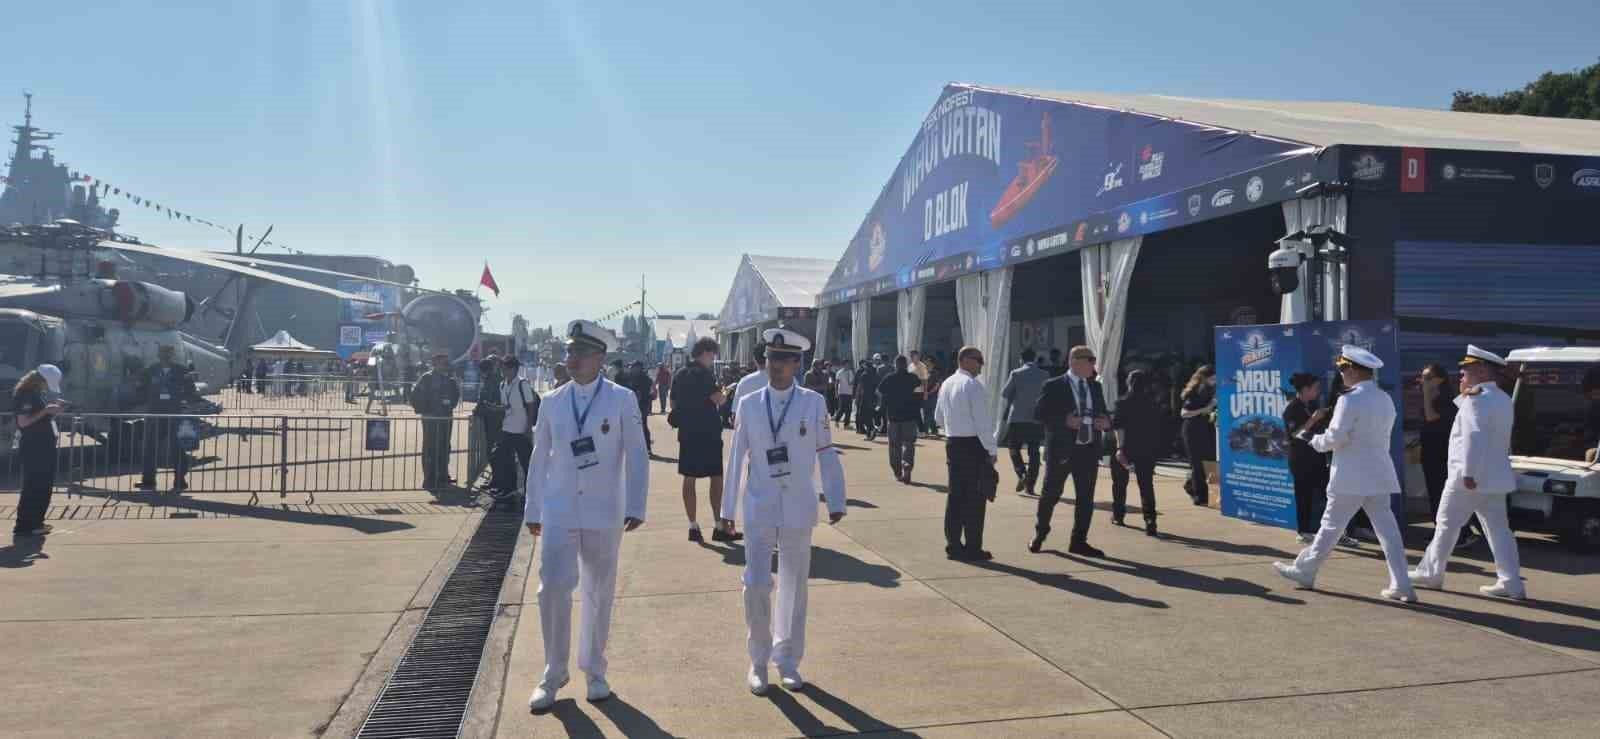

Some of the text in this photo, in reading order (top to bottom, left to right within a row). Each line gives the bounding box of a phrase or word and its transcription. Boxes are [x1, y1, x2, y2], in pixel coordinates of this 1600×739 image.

[1407, 158, 1418, 179] D
[924, 181, 969, 241] D BLOK
